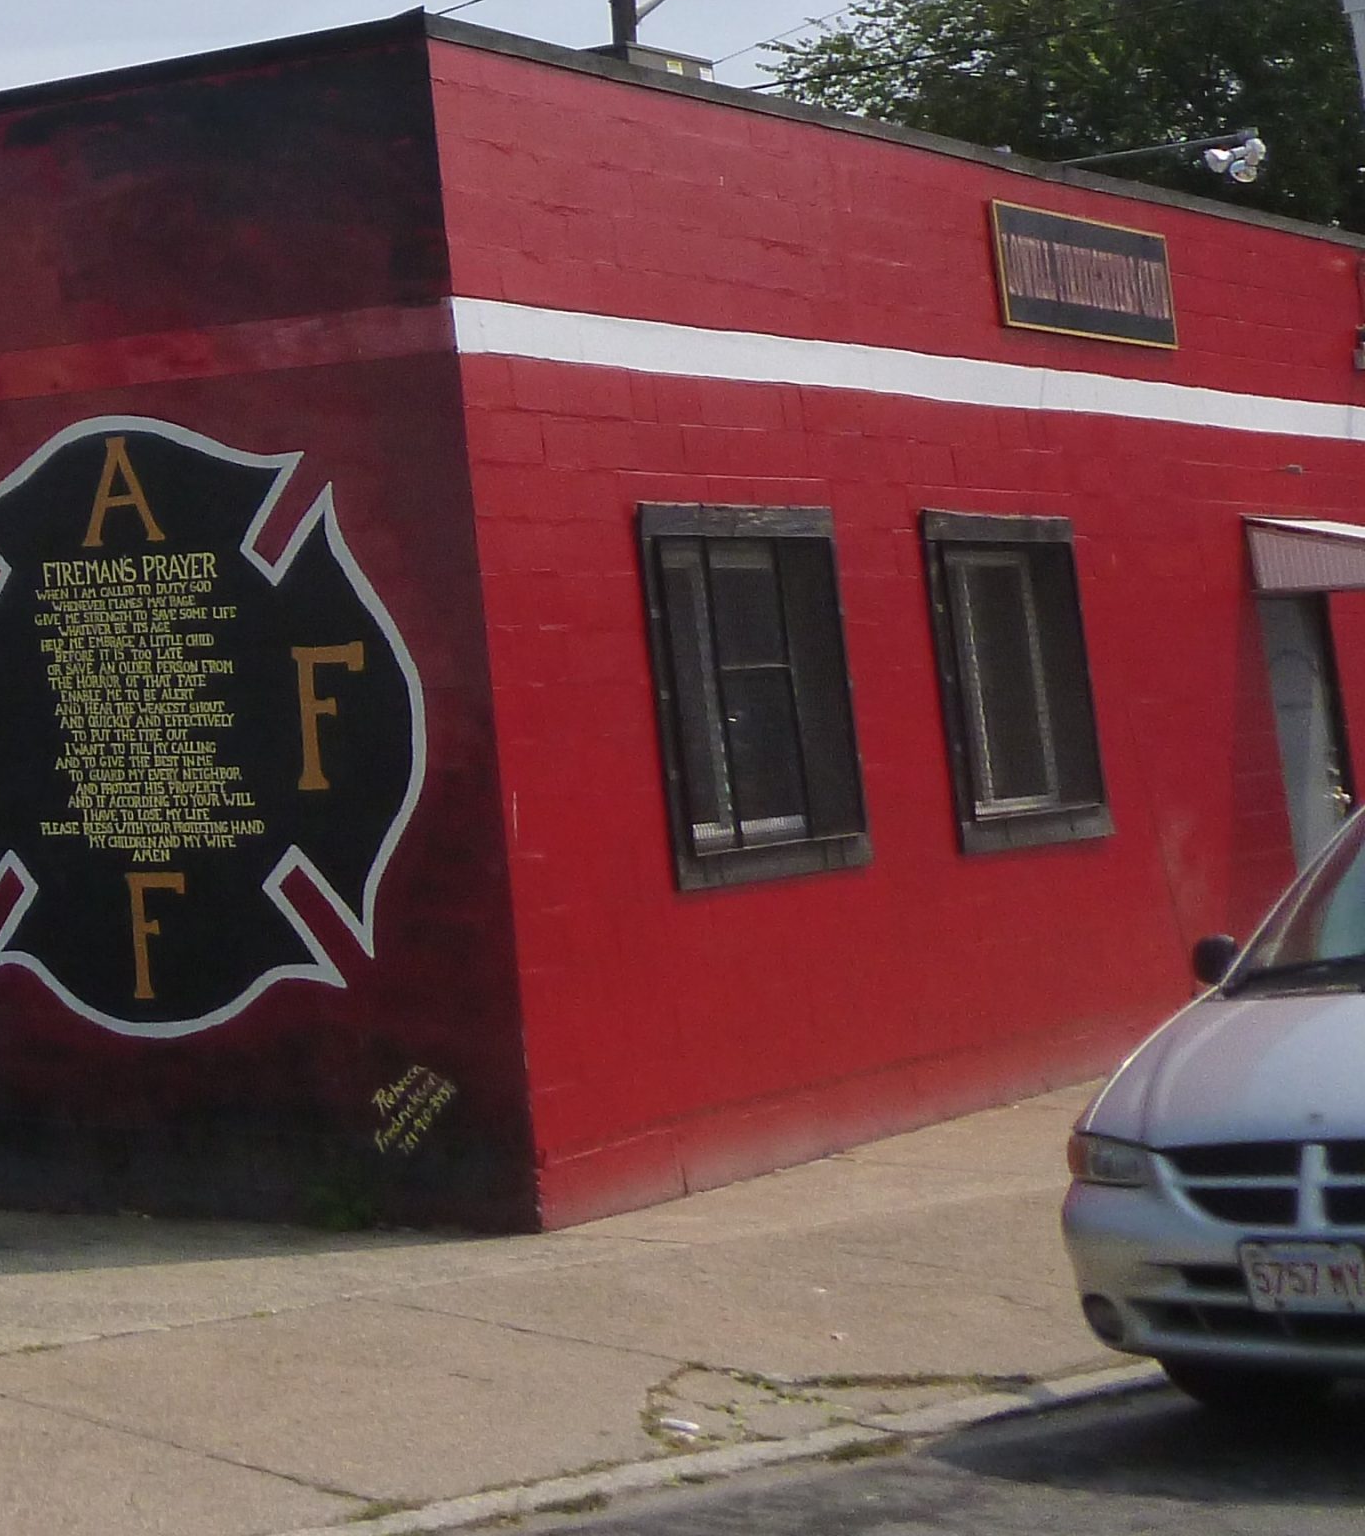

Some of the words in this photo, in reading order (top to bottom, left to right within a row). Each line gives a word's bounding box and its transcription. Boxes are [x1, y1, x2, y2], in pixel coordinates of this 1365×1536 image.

[83, 437, 165, 547] A
[43, 555, 136, 587] FIREMAN'S
[142, 552, 217, 580] PRAYER
[35, 588, 68, 600] WHEN
[74, 588, 78, 599] I
[82, 587, 96, 598] AM
[101, 585, 134, 597] CALLED
[136, 584, 151, 595] TO
[157, 583, 185, 594] DUTY
[190, 581, 211, 593] GOD
[52, 600, 106, 612] WHENEVER
[147, 597, 165, 608] MAY
[169, 595, 196, 607] RAGE
[35, 613, 60, 625] GIVE
[66, 613, 80, 624] ME
[84, 610, 132, 623] STRENGTH
[134, 610, 147, 621] TO
[152, 608, 177, 620] SAVE
[180, 608, 207, 619] SOME
[213, 606, 237, 619] LIFE
[58, 624, 110, 636] WHATEVER
[114, 623, 127, 634] BE
[133, 623, 148, 633] ITS
[151, 622, 170, 633] AGE
[41, 638, 64, 652] HELP
[70, 637, 84, 648] ME
[89, 636, 135, 648] EMBRACE
[139, 635, 146, 647] A
[150, 634, 183, 647] LITTLE
[186, 633, 214, 646] CHILD
[55, 649, 94, 663] BEFORE
[100, 649, 108, 660] IT
[114, 649, 124, 660] IS
[132, 648, 151, 660] TOO
[157, 647, 183, 659] LATE
[47, 664, 62, 676] OR
[66, 663, 93, 675] SAVE
[99, 662, 114, 675] AN
[119, 662, 151, 674] OLDER
[157, 661, 197, 674] PERSON
[202, 660, 234, 674] FROM
[48, 676, 70, 690] THE
[77, 675, 120, 688] HORROR
[143, 674, 171, 687] THAT
[177, 674, 206, 687] FATE
[61, 689, 100, 702] ENABLE
[107, 689, 121, 701] ME
[125, 689, 139, 700] TO
[144, 688, 156, 700] BE
[161, 688, 194, 700] ALERT
[55, 702, 80, 716] AND
[84, 702, 112, 715] HEAR
[114, 702, 135, 714] THE
[138, 702, 186, 714] WEAKEST
[189, 701, 225, 713] SHOUT
[291, 641, 364, 790] F
[60, 715, 84, 729] AND
[88, 715, 131, 728] QUICKLY
[135, 715, 160, 727] AND
[165, 713, 234, 727] EFFECTIVELY
[72, 729, 86, 742] TO
[91, 729, 110, 741] PUT
[114, 729, 135, 741] THE
[138, 729, 162, 741] FIRE
[166, 728, 188, 741] OUT
[65, 743, 69, 755] I
[72, 743, 105, 755] WANT
[110, 743, 125, 755] TO
[130, 743, 151, 755] FILL
[154, 742, 169, 755] MY
[171, 742, 216, 754] CALLING
[55, 757, 80, 770] AND
[82, 756, 96, 768] TO
[99, 756, 124, 767] GIVE
[129, 755, 149, 767] THE
[154, 755, 179, 767] BEST
[182, 755, 195, 766] IN
[197, 755, 212, 766] ME
[69, 769, 83, 782] TO
[89, 769, 125, 781] GUARD
[129, 768, 147, 780] MY
[148, 768, 177, 780] EVERY
[76, 782, 97, 795] AND
[101, 781, 141, 794] PROTECT
[145, 781, 164, 794] HIS
[169, 781, 226, 794] PROPERTY
[68, 795, 92, 808] AND
[109, 794, 170, 808] ACCORDING
[173, 794, 188, 807] TO
[190, 793, 221, 807] YOUR
[222, 792, 255, 807] WILL
[84, 809, 88, 822] I
[91, 809, 118, 822] HAVE
[120, 809, 134, 821] TO
[138, 809, 162, 821] LOSE
[166, 808, 183, 821] MY
[185, 807, 210, 820] LIFE
[40, 822, 80, 835] PLEASE
[83, 822, 114, 835] BLESS
[115, 822, 143, 835] WITH
[144, 821, 171, 834] YOUR
[173, 821, 228, 834] PROTECTING
[231, 820, 265, 834] HAND
[89, 835, 106, 848] MY
[108, 835, 158, 848] CHILDREN
[158, 835, 180, 848] AND
[183, 835, 201, 848] MY
[205, 835, 236, 848] WIFE
[132, 849, 170, 862] AMEN
[128, 872, 185, 999] F
